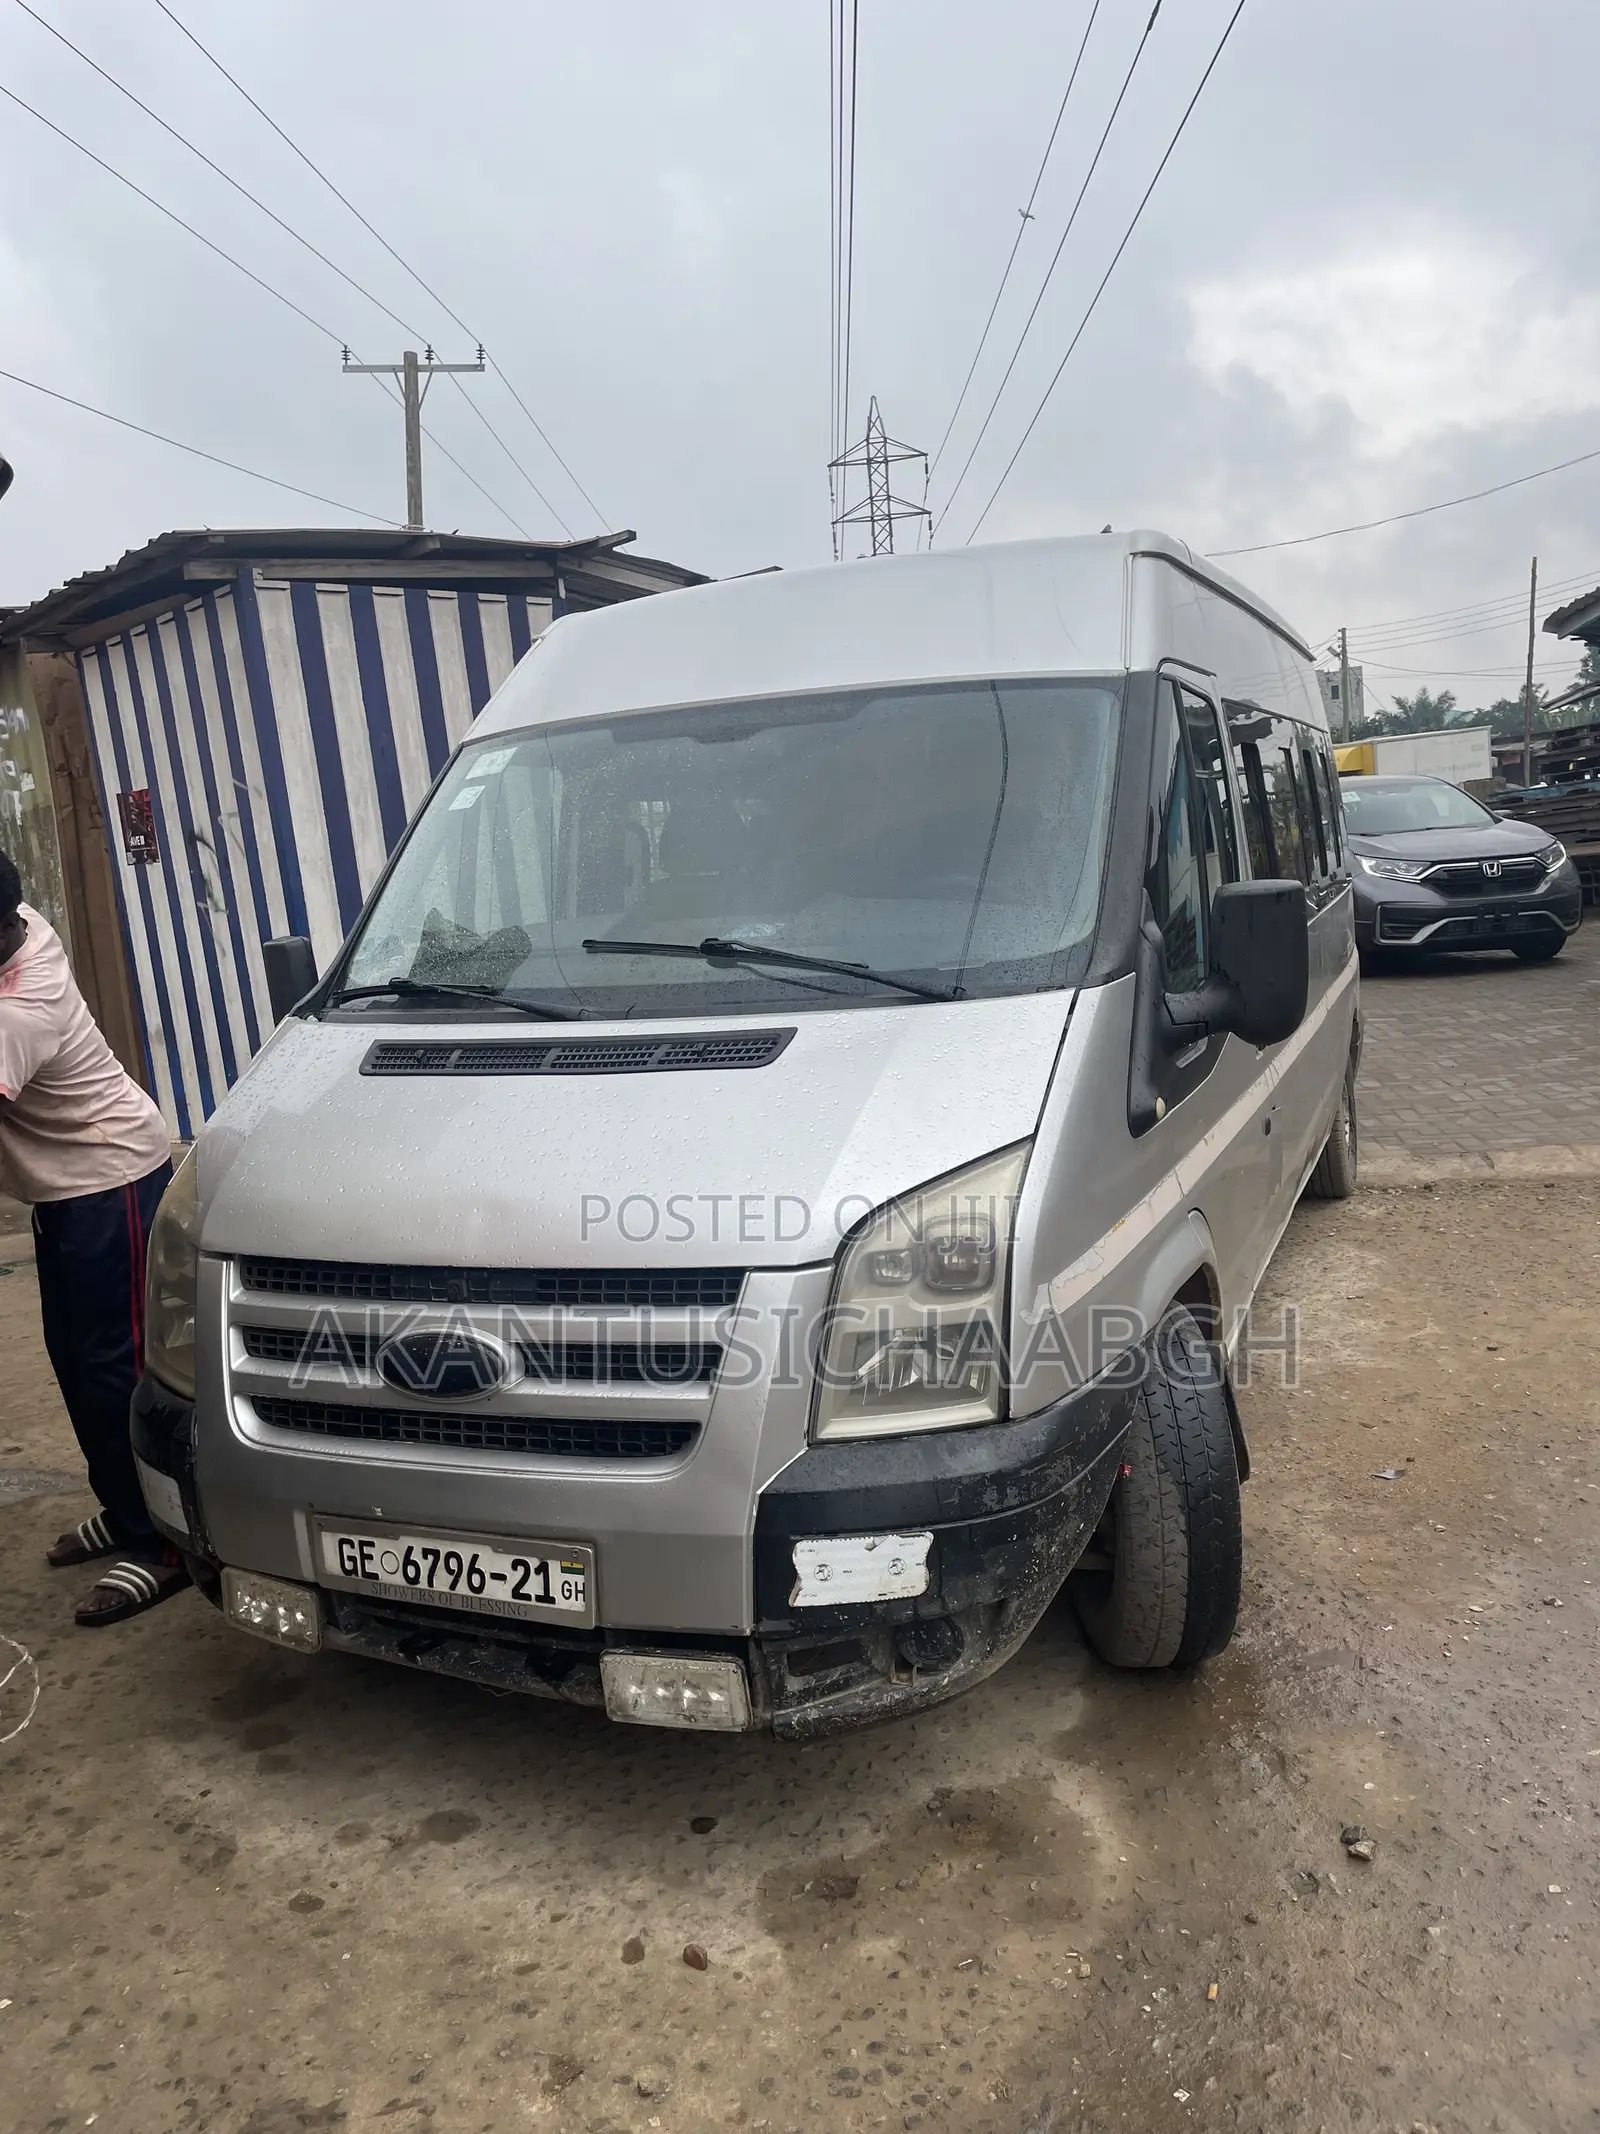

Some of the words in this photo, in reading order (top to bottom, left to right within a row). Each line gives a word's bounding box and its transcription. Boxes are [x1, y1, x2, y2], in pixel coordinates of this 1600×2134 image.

[338, 1537, 379, 1581] GE
[402, 1545, 556, 1605] 6796-21
[371, 1582, 434, 1604] SHOWERS
[438, 1592, 456, 1606] OF
[461, 1596, 527, 1617] BLESSING
[561, 1580, 585, 1603] GH
